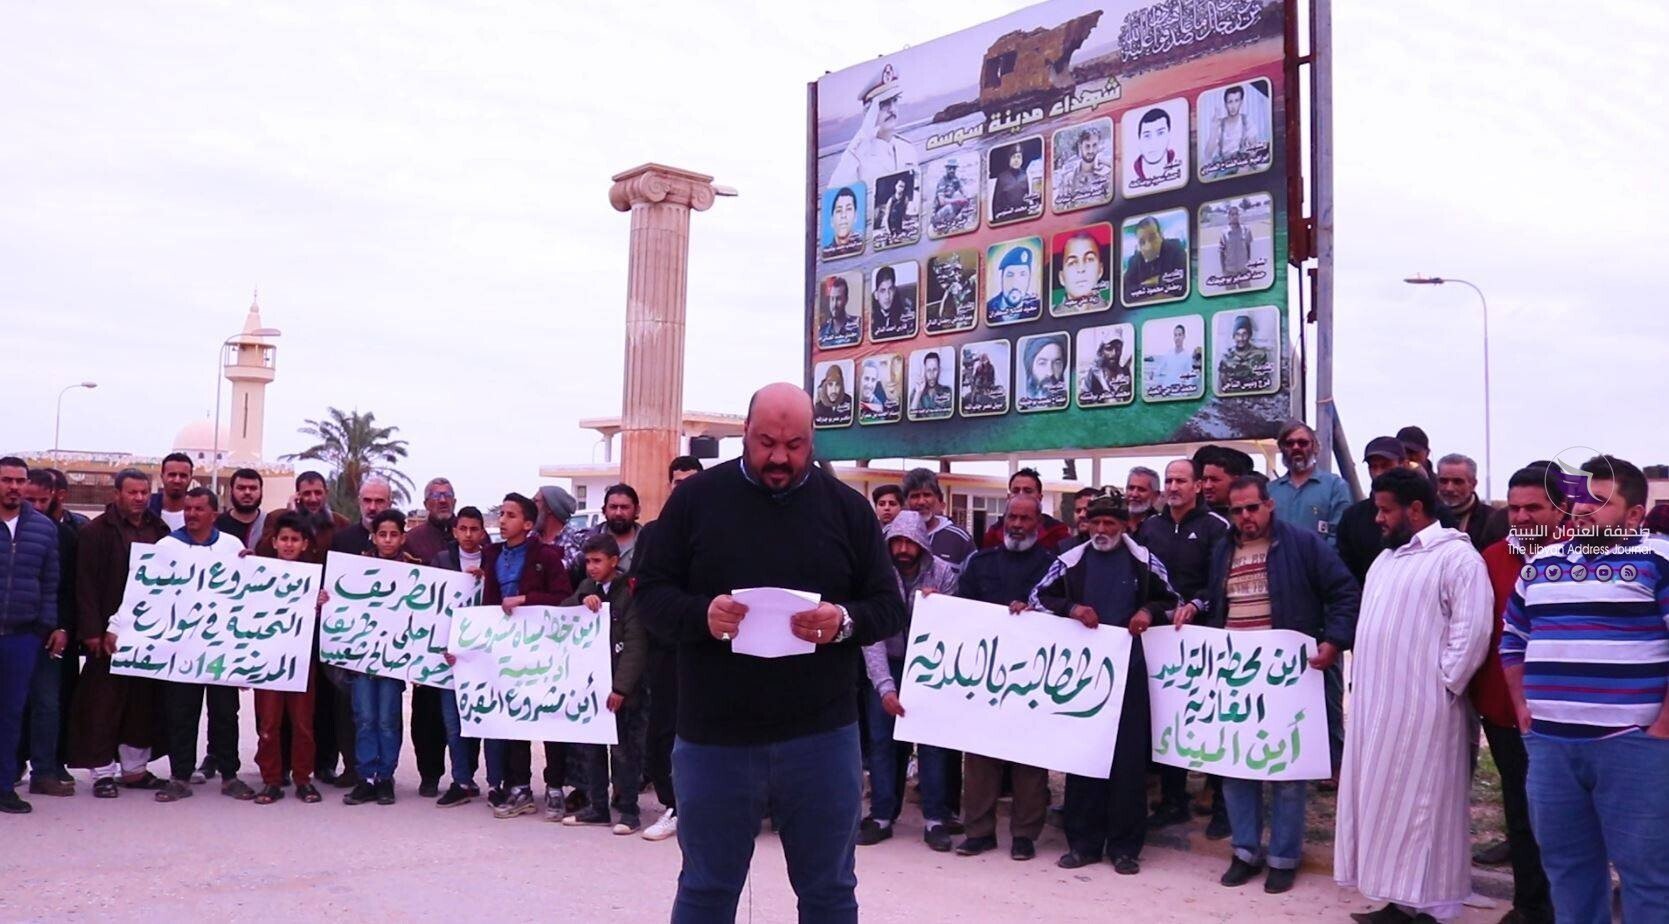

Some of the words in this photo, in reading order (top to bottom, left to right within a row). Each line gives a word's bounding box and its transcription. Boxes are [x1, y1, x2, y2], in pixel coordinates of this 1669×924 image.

[1049, 75, 1120, 112] شهداء
[988, 107, 1044, 134] مدينة
[134, 552, 205, 596] البنية
[207, 561, 278, 600] مشروع
[274, 573, 311, 603] اين
[334, 568, 447, 615] الطريق
[132, 600, 204, 642] شوارع
[226, 605, 303, 641] التحتية
[322, 605, 378, 643] طريق
[110, 643, 176, 679] اسفلت
[228, 642, 297, 684] المدينة
[906, 632, 1007, 707] بالبلدية
[999, 642, 1115, 719] المطالبة
[1150, 638, 1213, 690] التوليد
[1215, 632, 1263, 687] محطة
[1266, 642, 1308, 687] اين
[459, 681, 504, 724] المقبرة
[505, 686, 566, 722] مشروع
[565, 671, 599, 724] أين
[1184, 687, 1265, 726] الغازية
[1153, 711, 1240, 768] الميناء
[1245, 707, 1306, 775] أين
